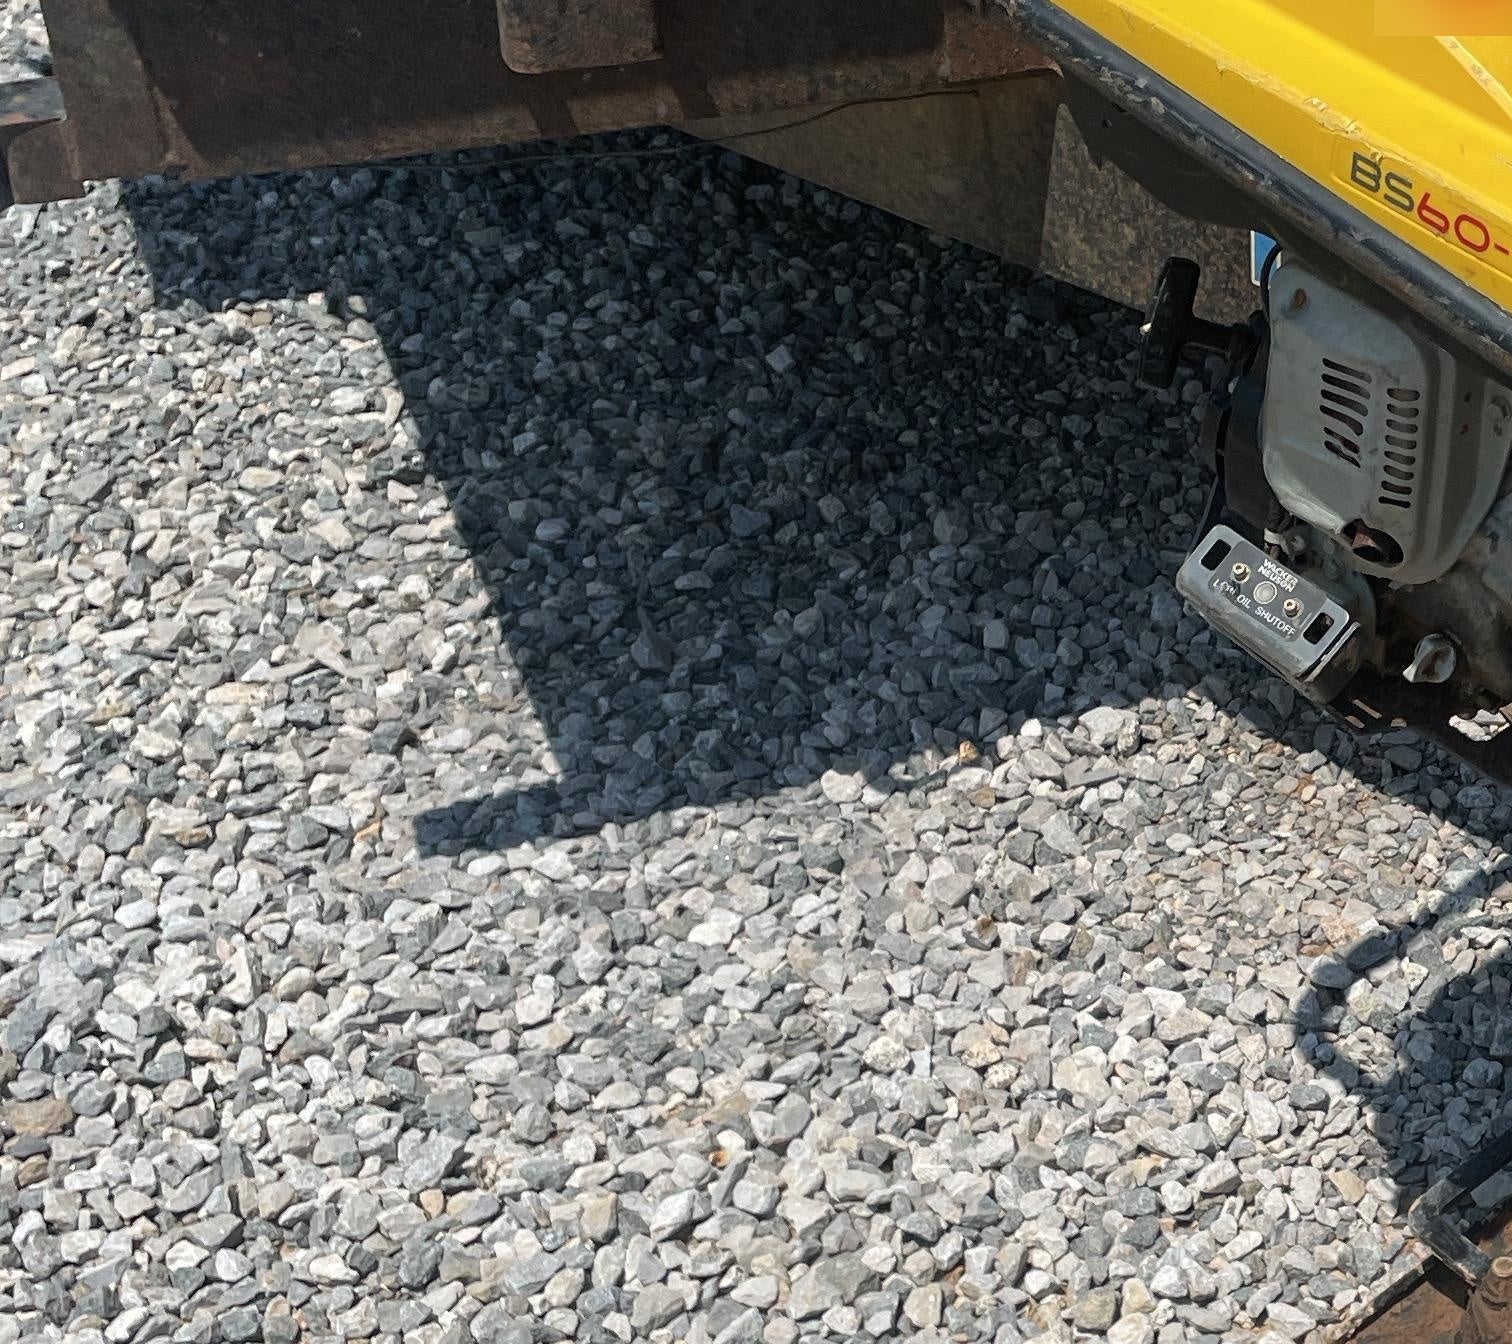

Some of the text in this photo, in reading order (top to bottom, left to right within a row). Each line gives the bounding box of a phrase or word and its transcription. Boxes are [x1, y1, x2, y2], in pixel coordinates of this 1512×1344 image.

[1258, 565, 1296, 593] NEUSON
[1263, 558, 1299, 585] WACKER
[1236, 594, 1251, 609] OIL
[1255, 606, 1297, 636] SHUTOFF
